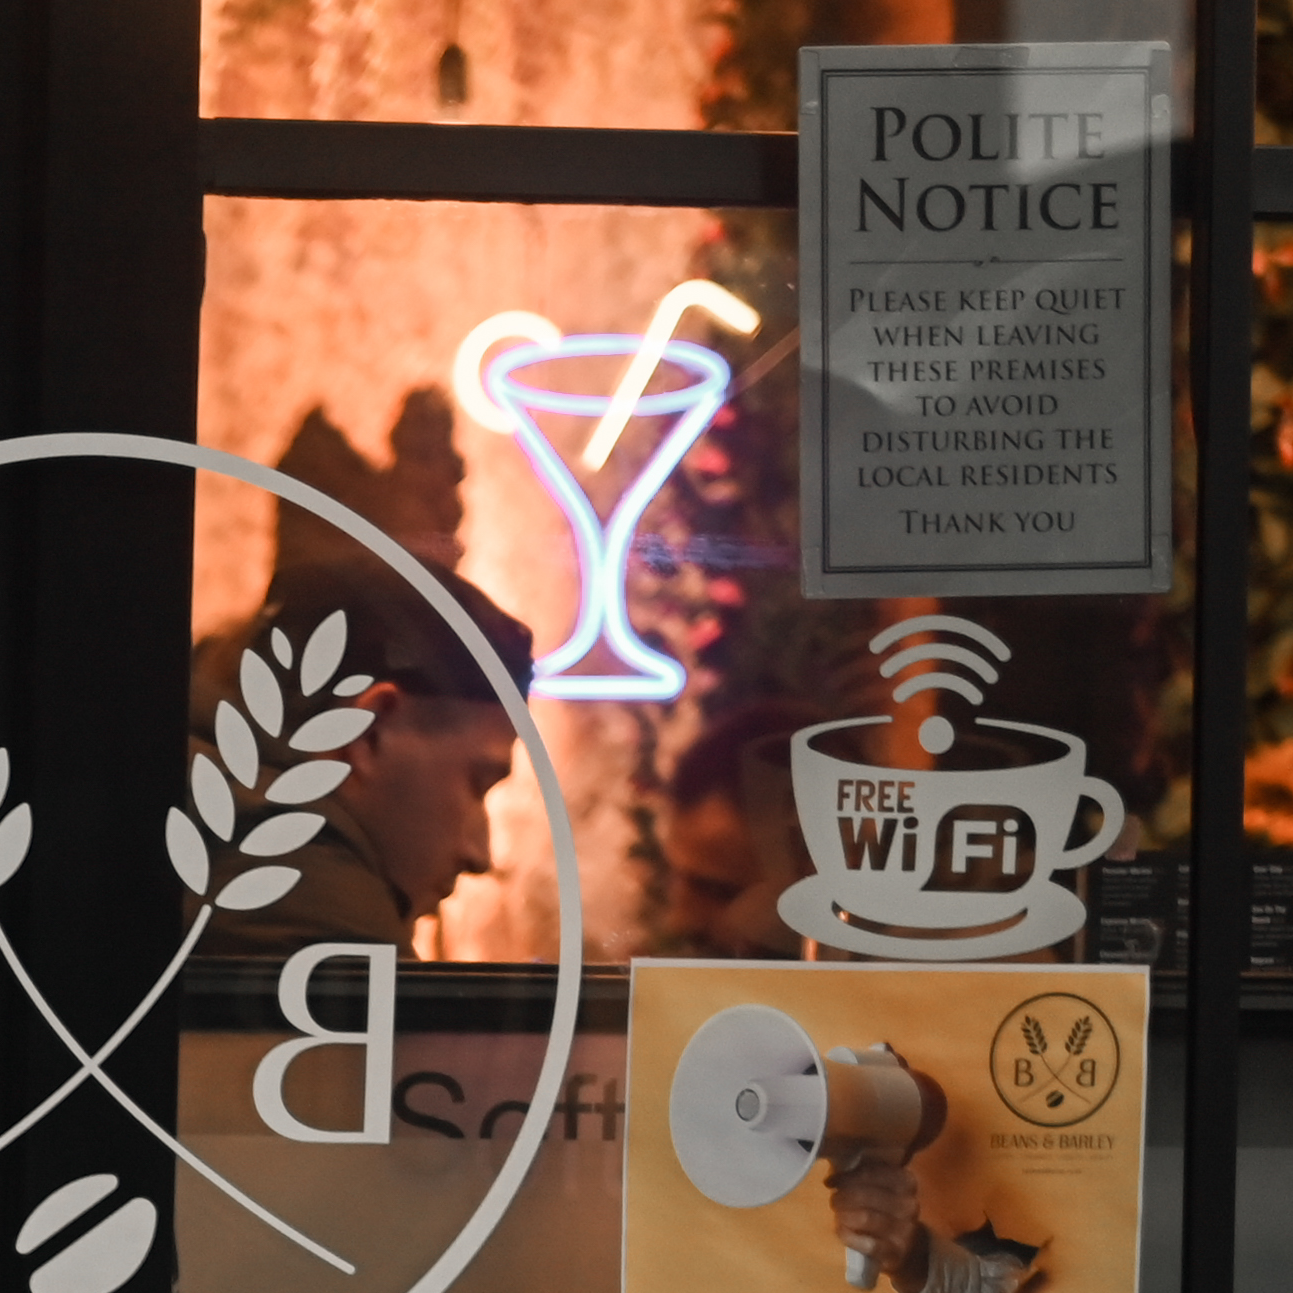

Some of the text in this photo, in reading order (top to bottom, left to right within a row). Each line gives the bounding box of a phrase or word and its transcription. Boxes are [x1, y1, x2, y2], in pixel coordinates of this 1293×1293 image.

[870, 106, 1106, 162] POLITE
[856, 177, 1119, 232] NOTICE
[849, 287, 1126, 315] PLEASE KEEP QUIET
[873, 323, 1099, 347] WHEN LEAVING
[867, 358, 1106, 382] THESE PREMISES
[916, 394, 1059, 417] TO AVOID
[862, 428, 1114, 453] DISTURBING THE
[858, 463, 1118, 488] LOCAL RESIDENTS
[900, 509, 1075, 535] THANK YOU
[837, 779, 916, 814] FREE
